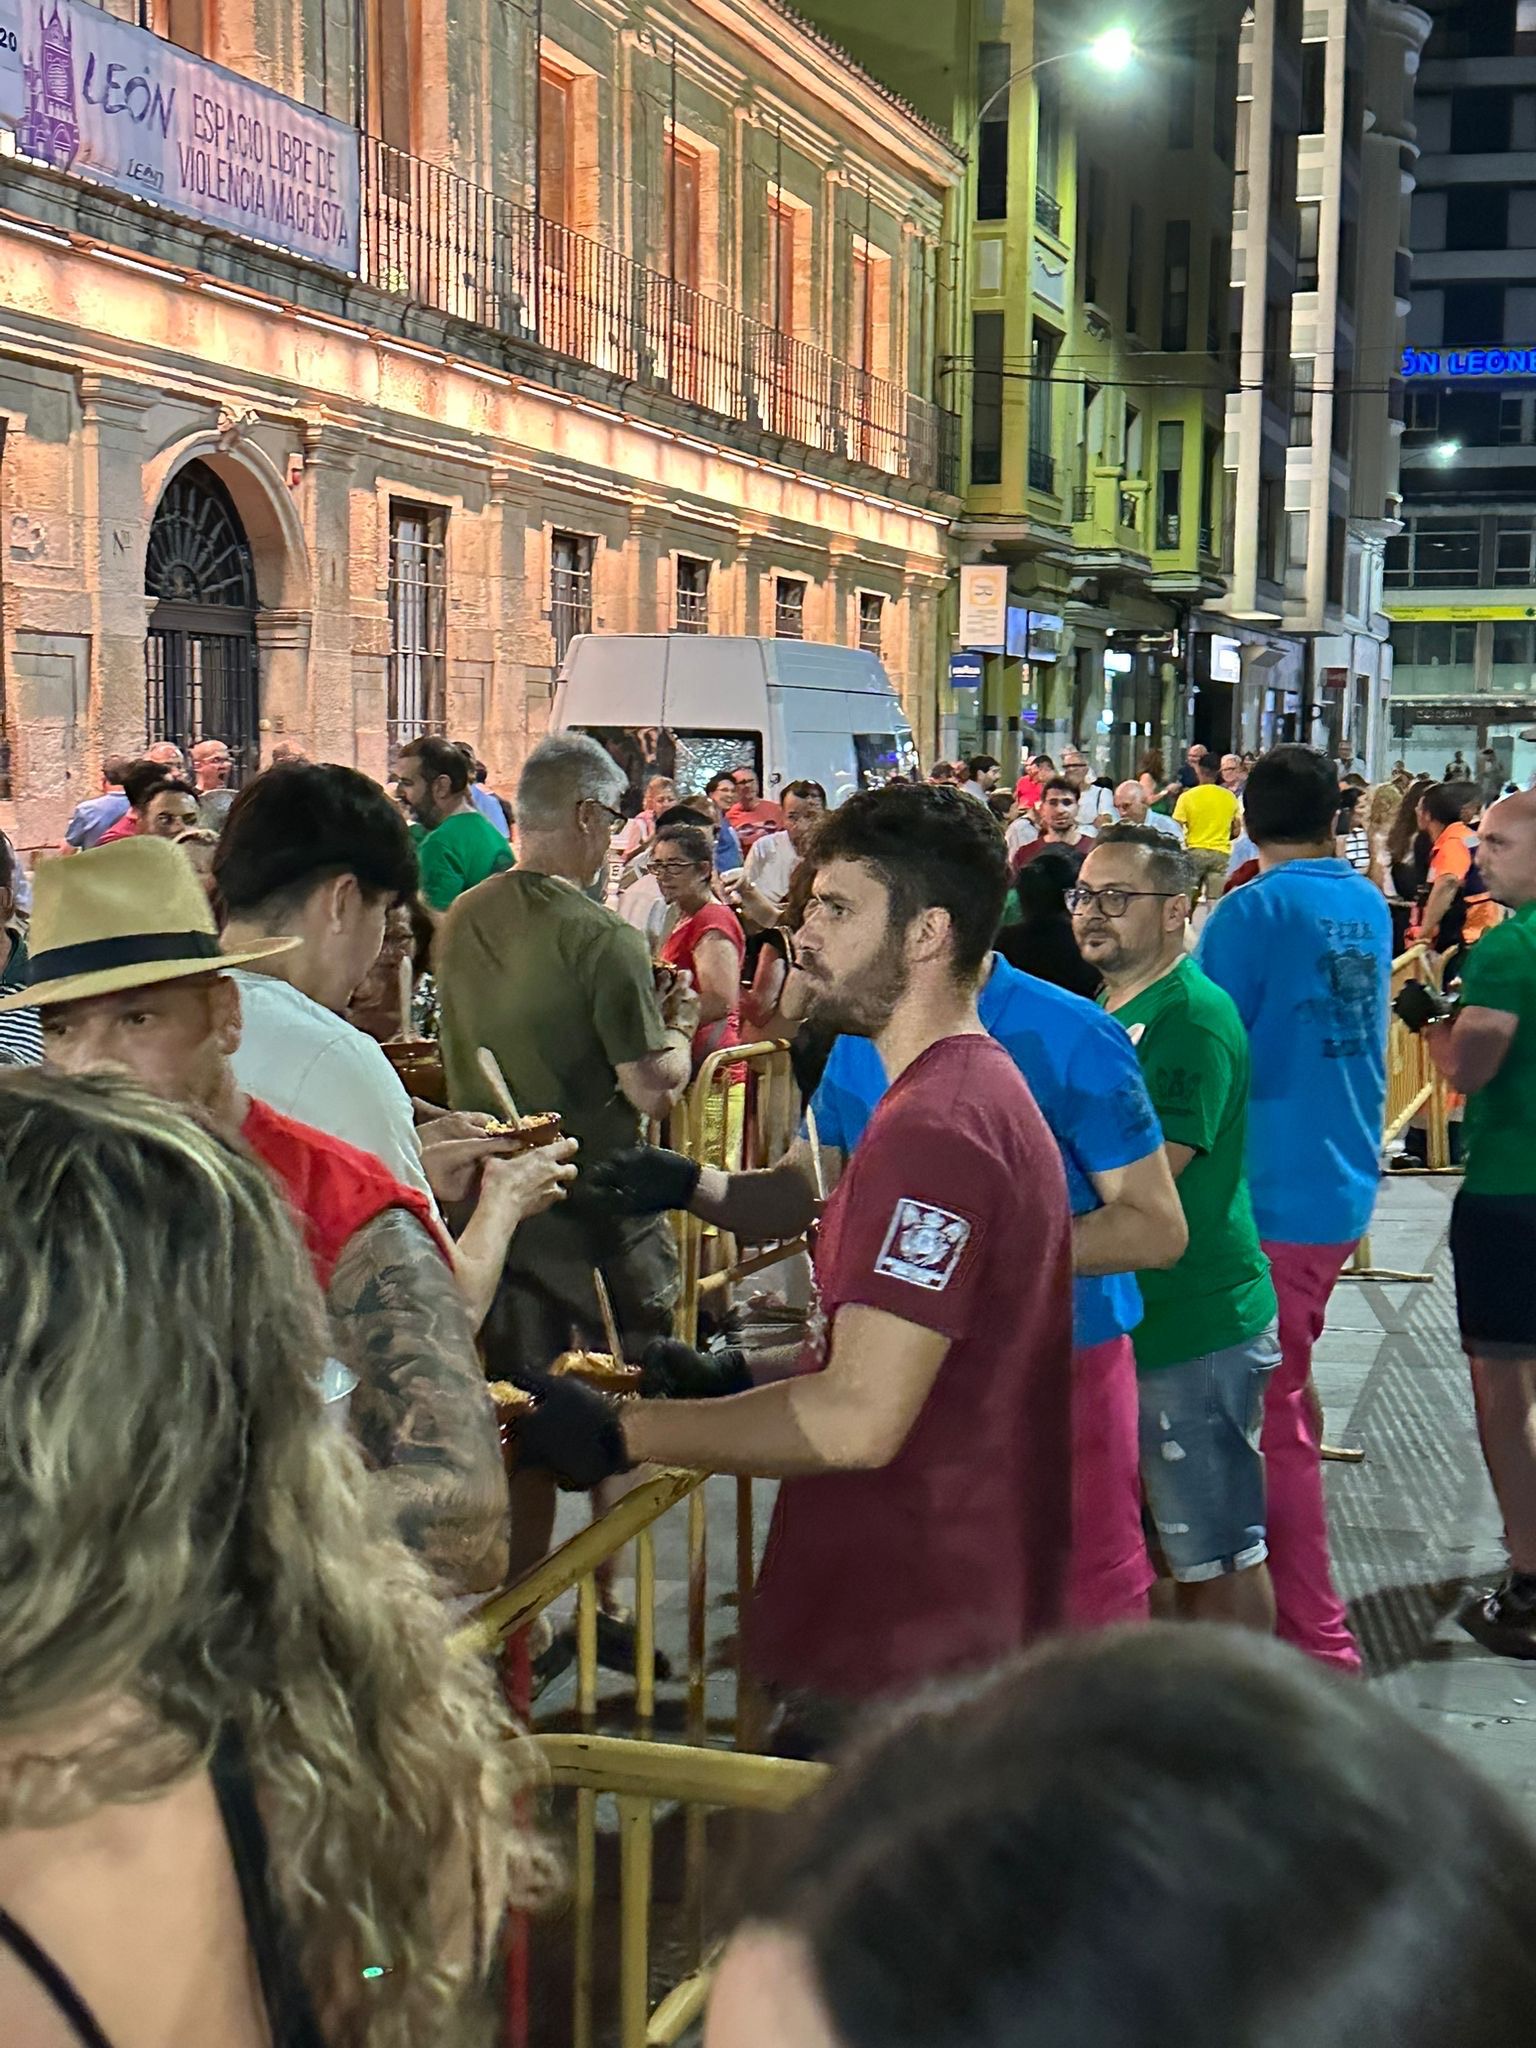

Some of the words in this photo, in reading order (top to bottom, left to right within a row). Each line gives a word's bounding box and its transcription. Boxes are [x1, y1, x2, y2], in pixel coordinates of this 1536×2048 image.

[82, 51, 176, 139] LEÓN
[193, 93, 263, 164] ESPACIO
[267, 126, 313, 184] LIBRE
[317, 147, 337, 193] DE
[177, 141, 266, 218] VIOLENCIA
[270, 179, 349, 248] MACHISTA
